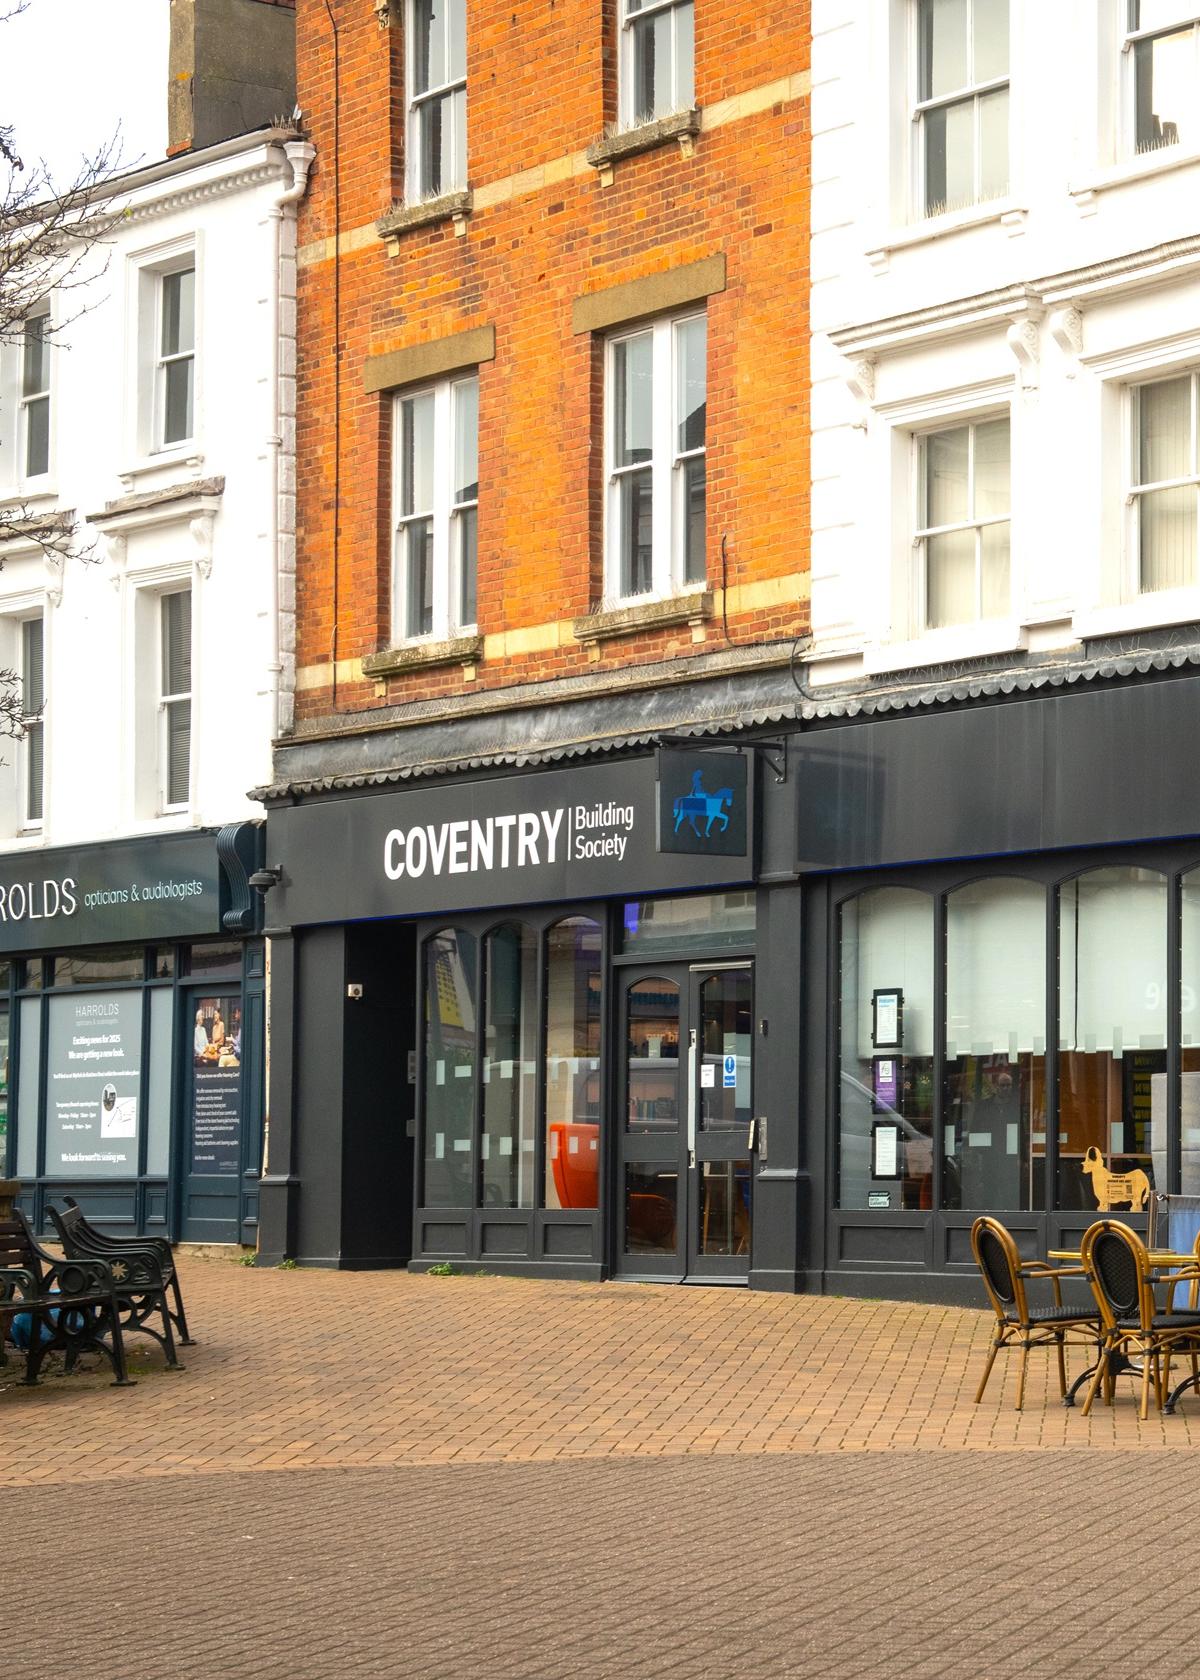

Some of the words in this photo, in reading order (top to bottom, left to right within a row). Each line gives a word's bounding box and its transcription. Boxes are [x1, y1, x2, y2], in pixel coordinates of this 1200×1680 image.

[574, 801, 635, 831] Building
[383, 808, 565, 881] COVENTRY
[574, 832, 628, 862] Society
[84, 888, 129, 911] opticians
[130, 884, 140, 902] &
[142, 879, 203, 902] audiologists
[75, 1003, 119, 1017] HARROLDS
